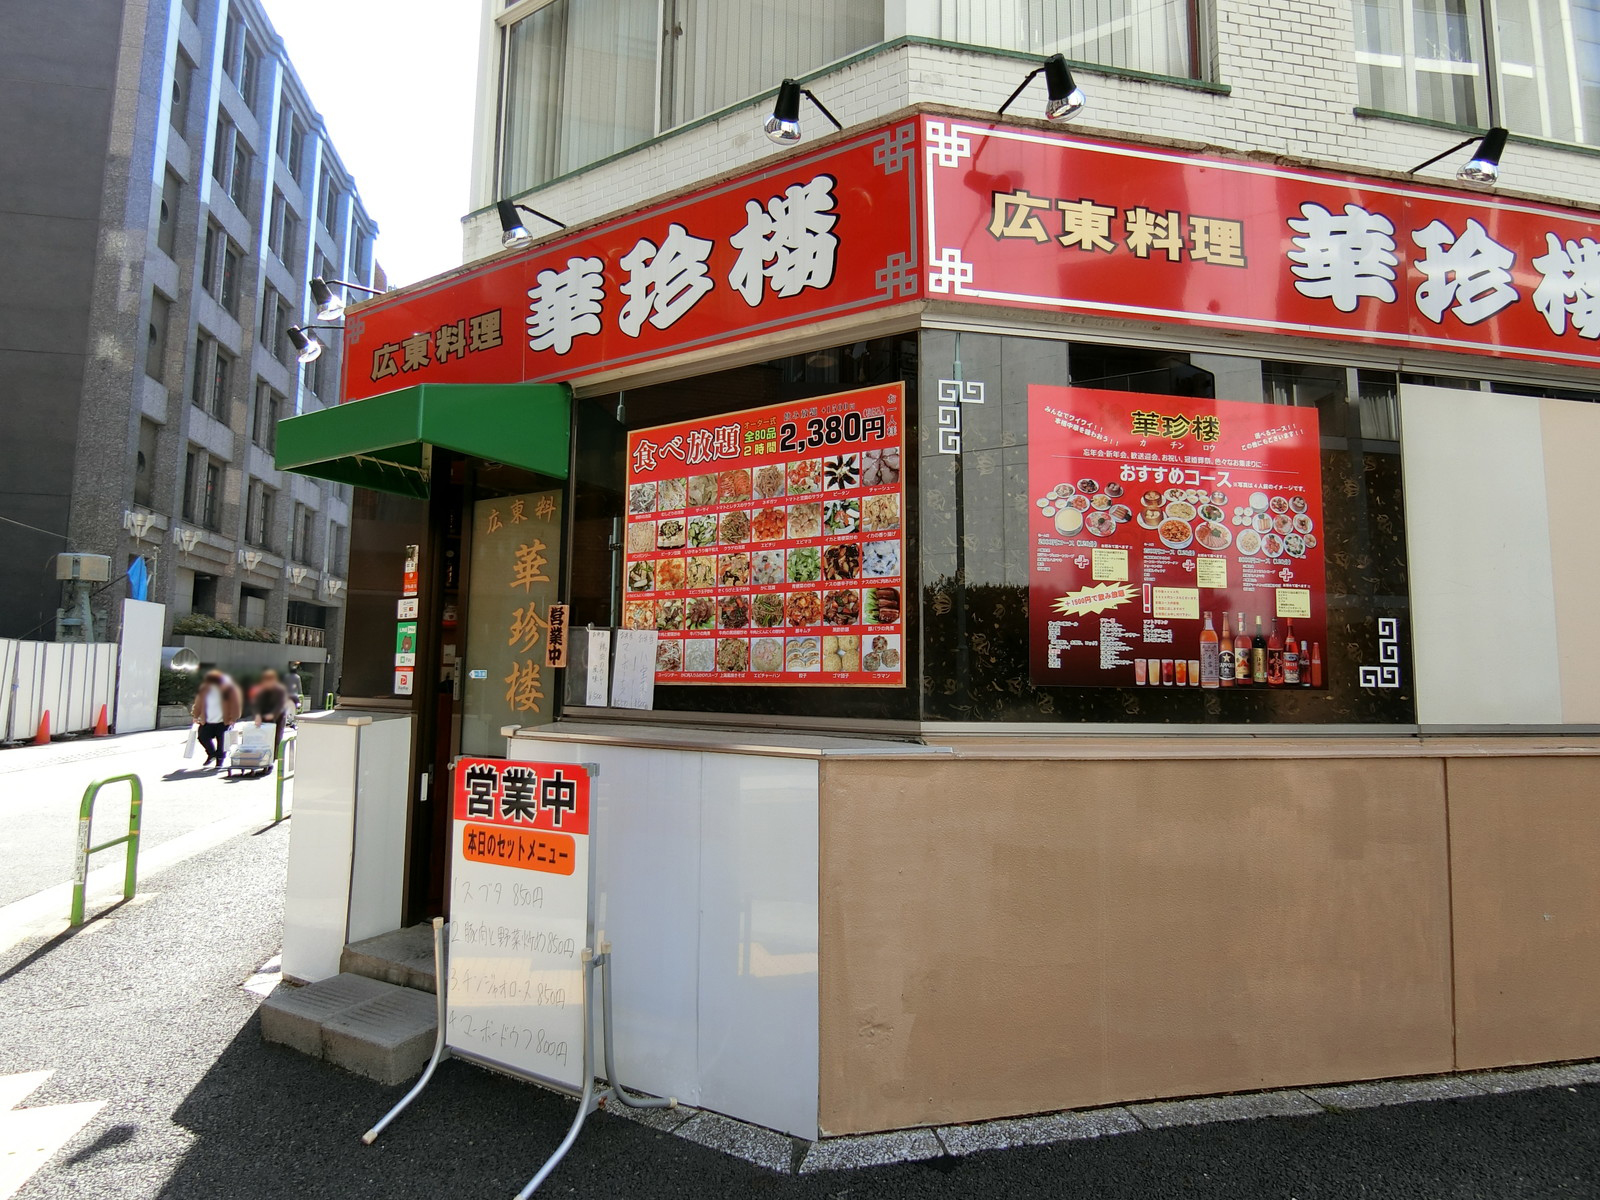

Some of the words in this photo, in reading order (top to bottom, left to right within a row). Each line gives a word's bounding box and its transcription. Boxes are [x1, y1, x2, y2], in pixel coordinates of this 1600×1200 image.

[989, 188, 1248, 270] 広東料理
[369, 308, 502, 382] 広東料理
[525, 174, 841, 356] 華珍楼
[743, 416, 777, 429] オーダー式
[744, 427, 777, 443] 全80品
[780, 411, 886, 453] 2,380円
[1130, 410, 1222, 443] 華珍楼
[633, 423, 742, 474] 食べ放題
[743, 441, 777, 457] 2時間
[1139, 439, 1147, 447] カ
[1170, 441, 1185, 451] チン
[1203, 445, 1216, 453] ロウ
[1120, 464, 1232, 489] おすすめコース
[486, 496, 557, 535] 広東料
[504, 538, 551, 713] 華珍楼
[548, 607, 565, 665] 営業中
[464, 763, 577, 827] 営業中
[467, 829, 569, 866] 本日のセットメニュー
[513, 883, 544, 909] 850円
[537, 983, 566, 1009] 850円
[536, 1029, 568, 1067] 800円
